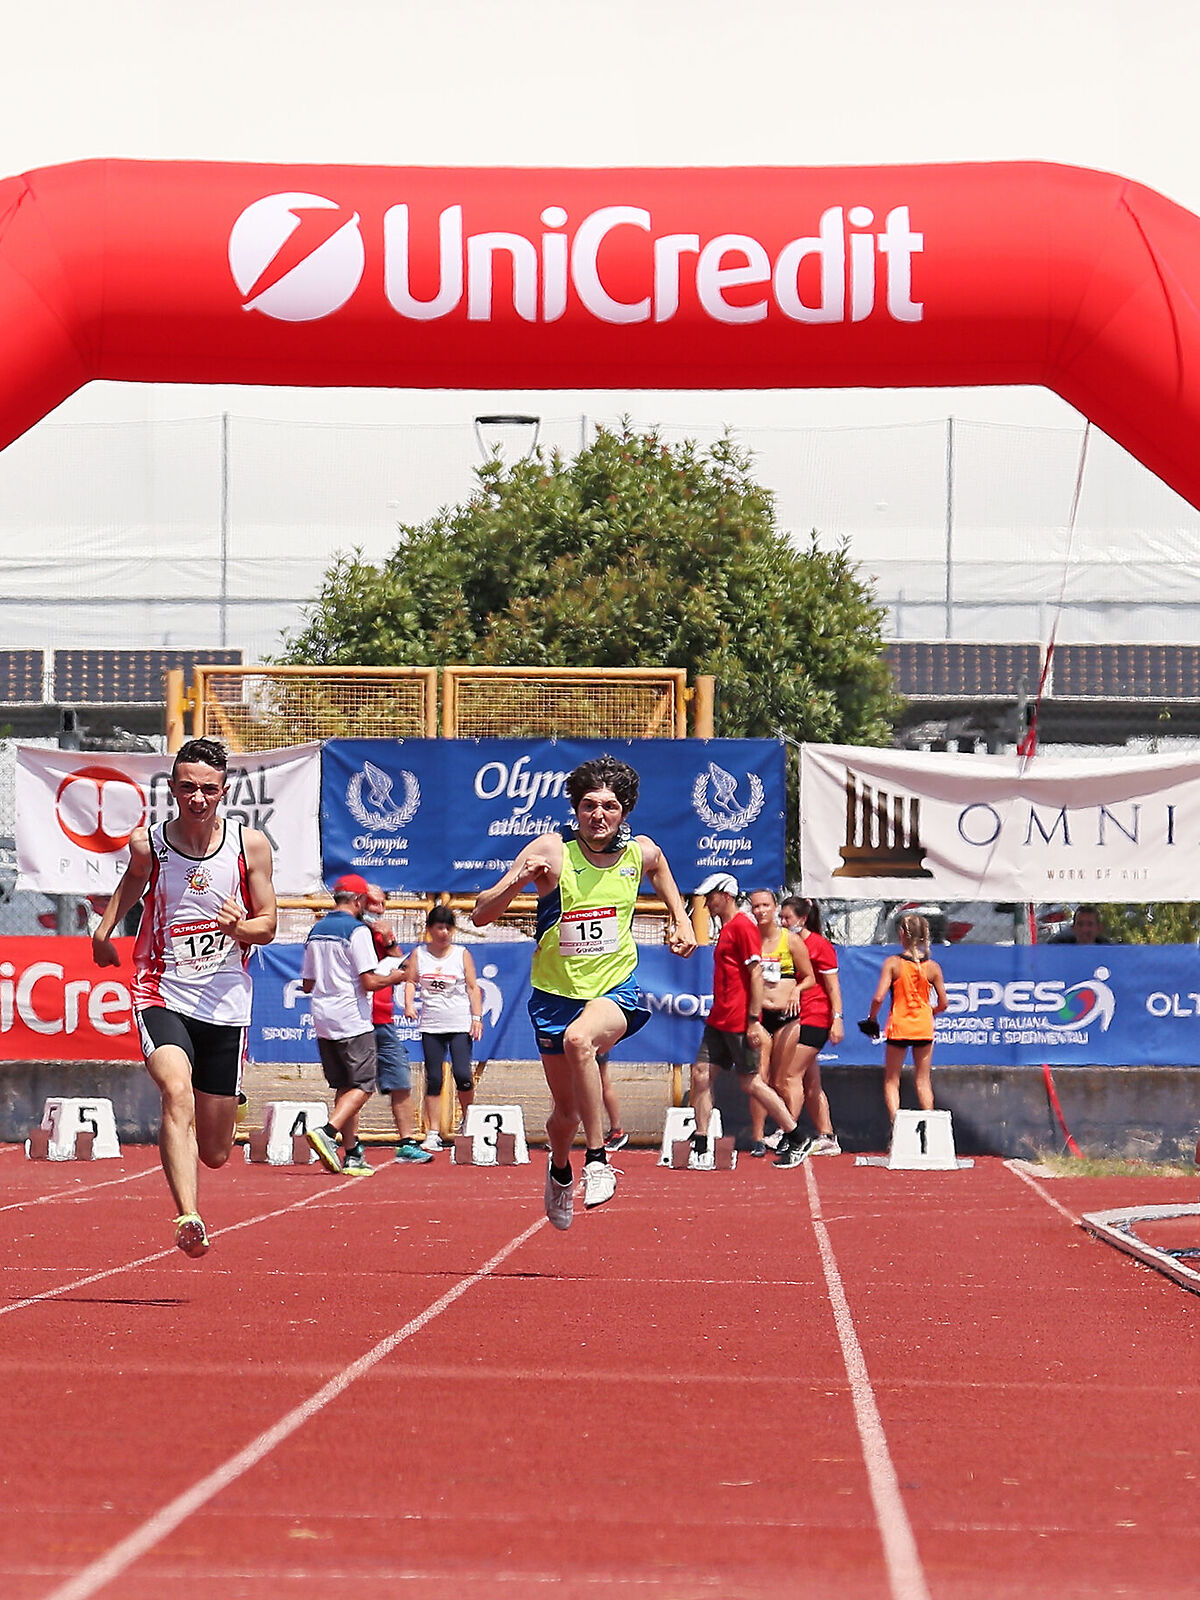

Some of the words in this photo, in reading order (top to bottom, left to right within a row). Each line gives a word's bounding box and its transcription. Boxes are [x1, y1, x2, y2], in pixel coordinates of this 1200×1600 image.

[384, 204, 924, 323] UniCredit
[474, 755, 571, 815] Olym
[957, 803, 1177, 846] OMNI
[352, 832, 408, 857] Olympia
[697, 834, 752, 856] Olympia
[184, 931, 227, 958] 127
[576, 921, 603, 941] 15
[945, 981, 1067, 1014] SPES
[933, 1031, 988, 1045] RALIMPICI
[935, 1017, 994, 1030] ERAZIONE
[79, 1106, 98, 1139] 5
[484, 1113, 502, 1147] 3
[915, 1119, 928, 1155] 1
